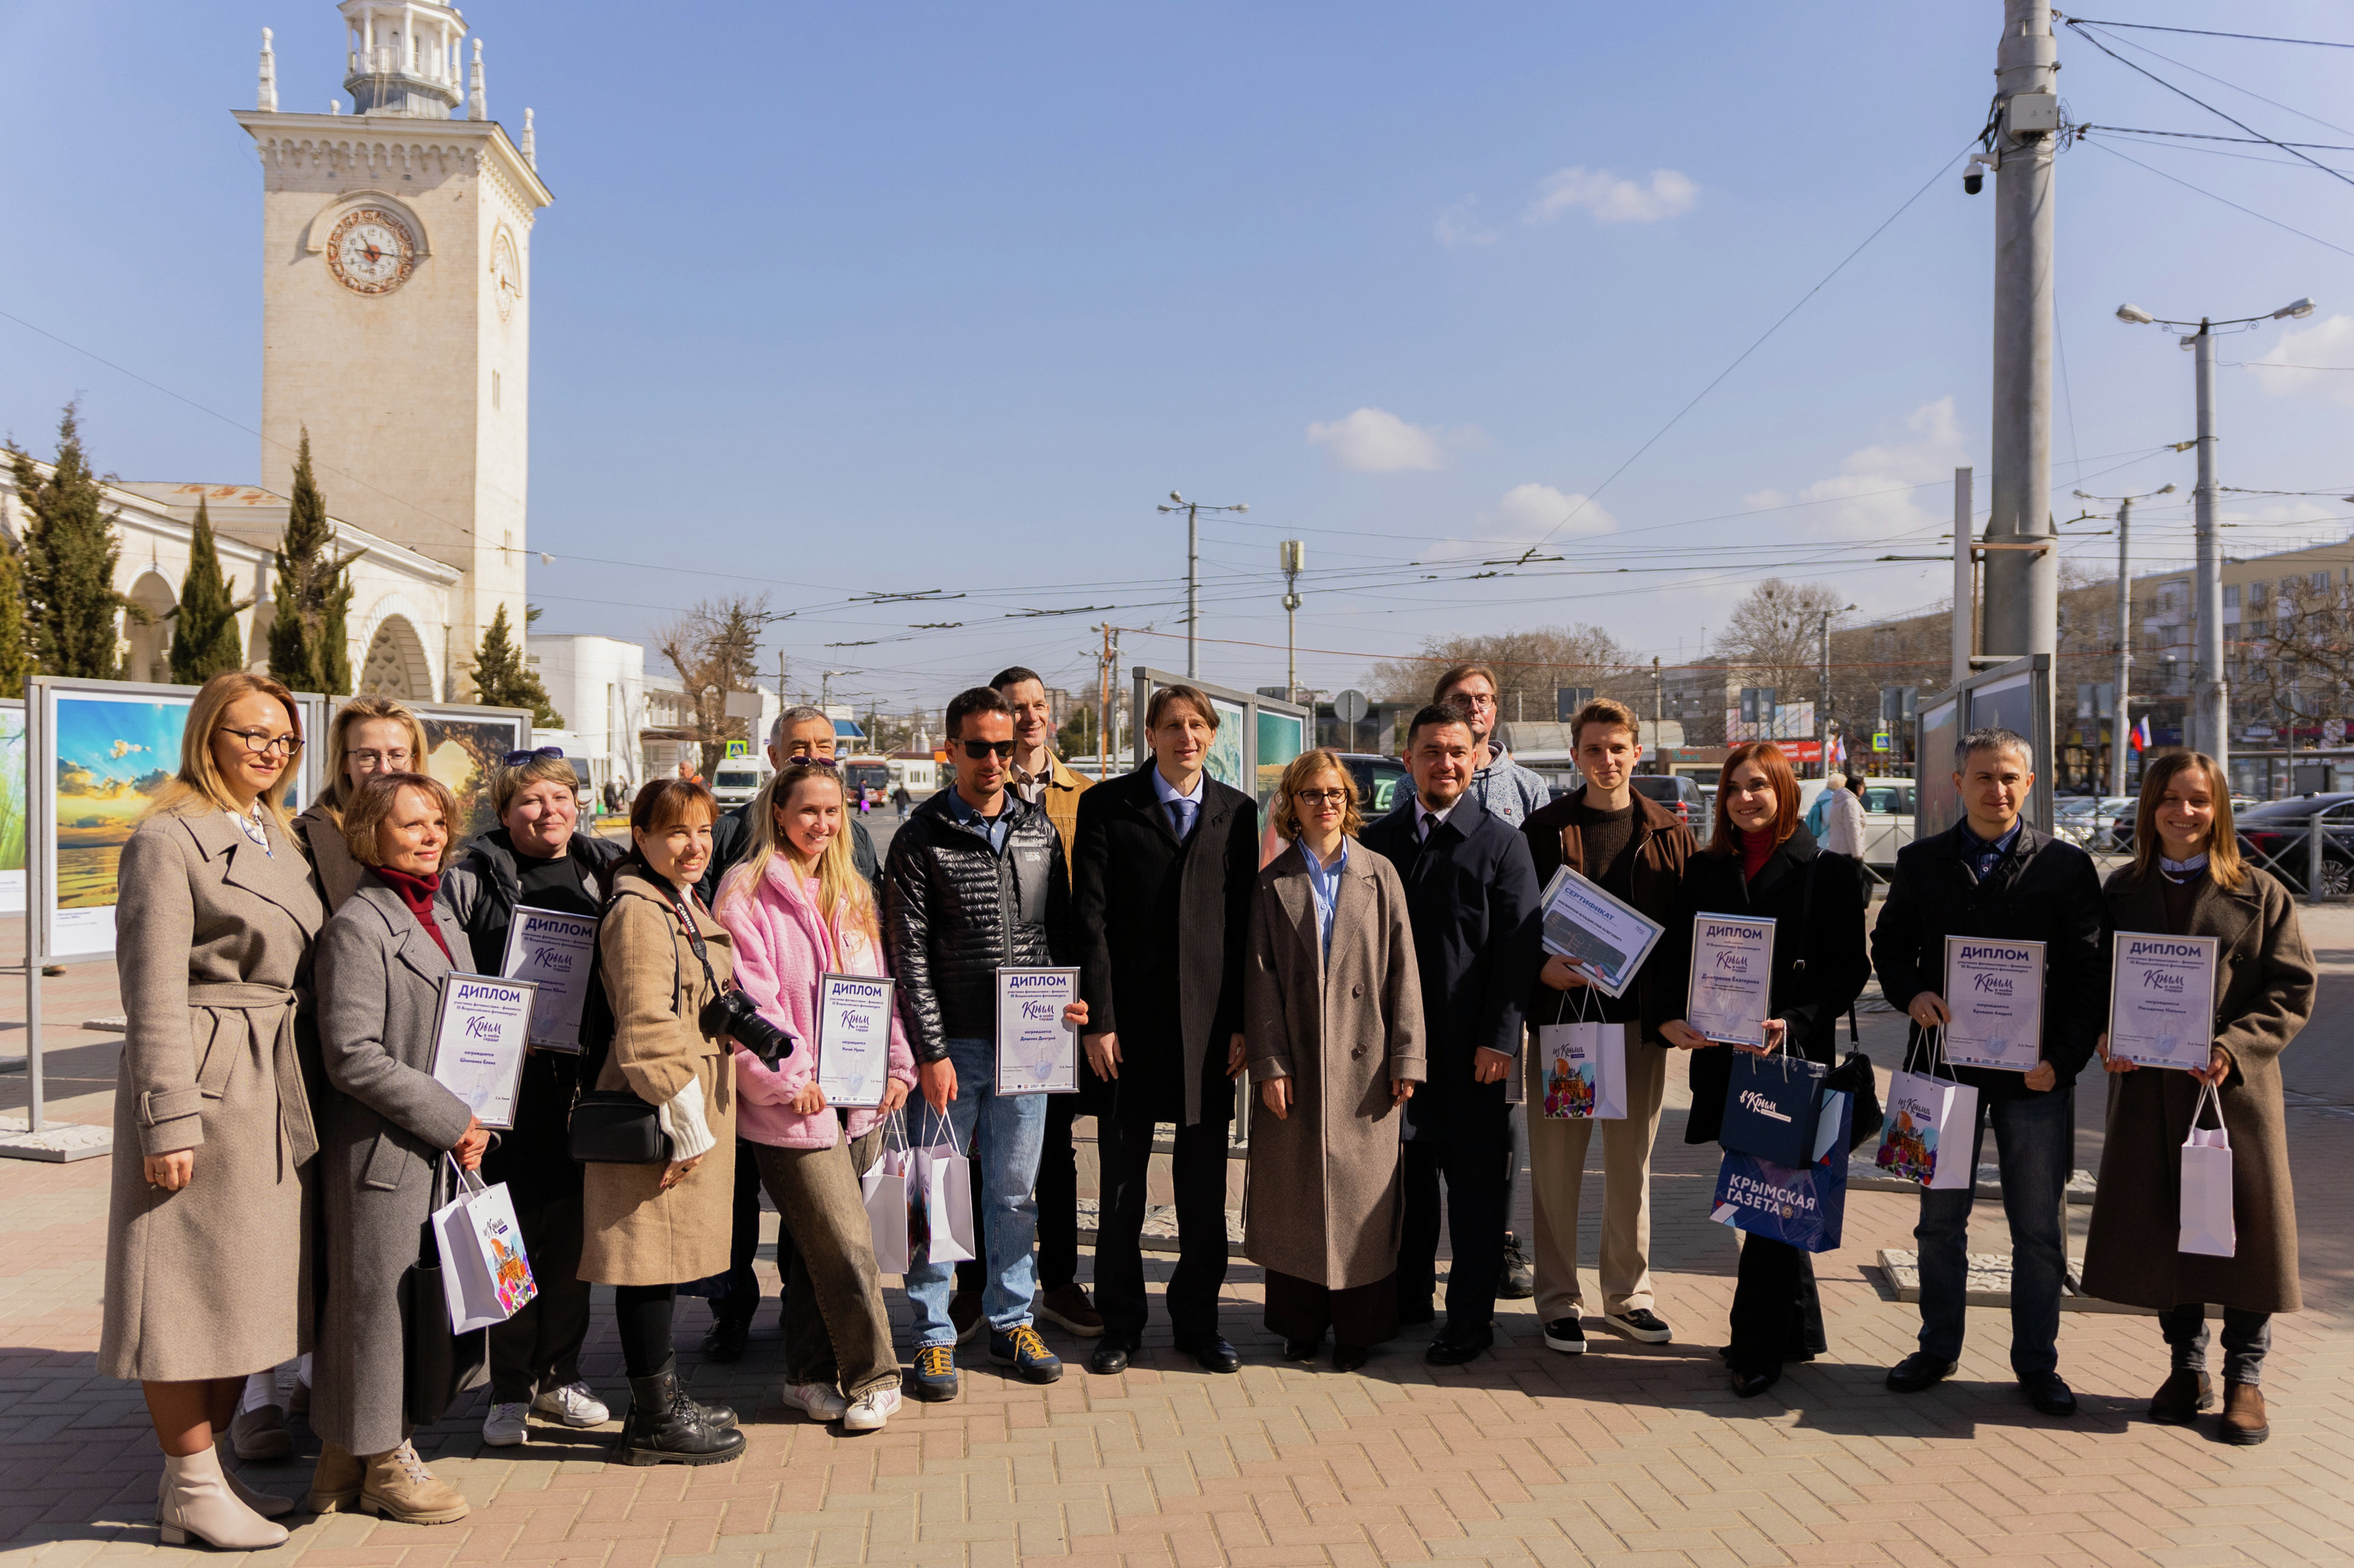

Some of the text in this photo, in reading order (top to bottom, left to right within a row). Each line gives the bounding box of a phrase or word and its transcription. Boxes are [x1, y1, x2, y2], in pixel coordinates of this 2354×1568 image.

[1564, 888, 1615, 921] СЕРТИФИКАТ
[526, 917, 592, 938] ДИПЛОМ
[676, 903, 696, 933] Canon
[1578, 912, 1603, 930] ВЛАДИСЛАВ
[1706, 925, 1762, 939] ДИПЛОМ
[534, 947, 572, 968] Крым
[1960, 946, 2029, 961] ДИПЛОМ
[2129, 942, 2201, 957] ДИПЛОМ
[1716, 950, 1748, 970] Крым
[1010, 976, 1066, 988] ДИПЛОМ
[1974, 973, 2013, 993] Крым
[2144, 969, 2184, 989] Крым
[458, 984, 520, 1003] ДИПЛОМ
[832, 983, 882, 996] ДИПЛОМ
[841, 1010, 869, 1029] Крым
[1022, 1000, 1054, 1020] Крым
[466, 1016, 501, 1038] Крым
[1552, 1043, 1583, 1058] из Крыма
[1739, 1090, 1776, 1113] в Крым
[1898, 1098, 1930, 1115] из Крыма
[1726, 1188, 1781, 1215] ГАЗЕТА
[1729, 1173, 1816, 1211] КРЫМСКАЯ
